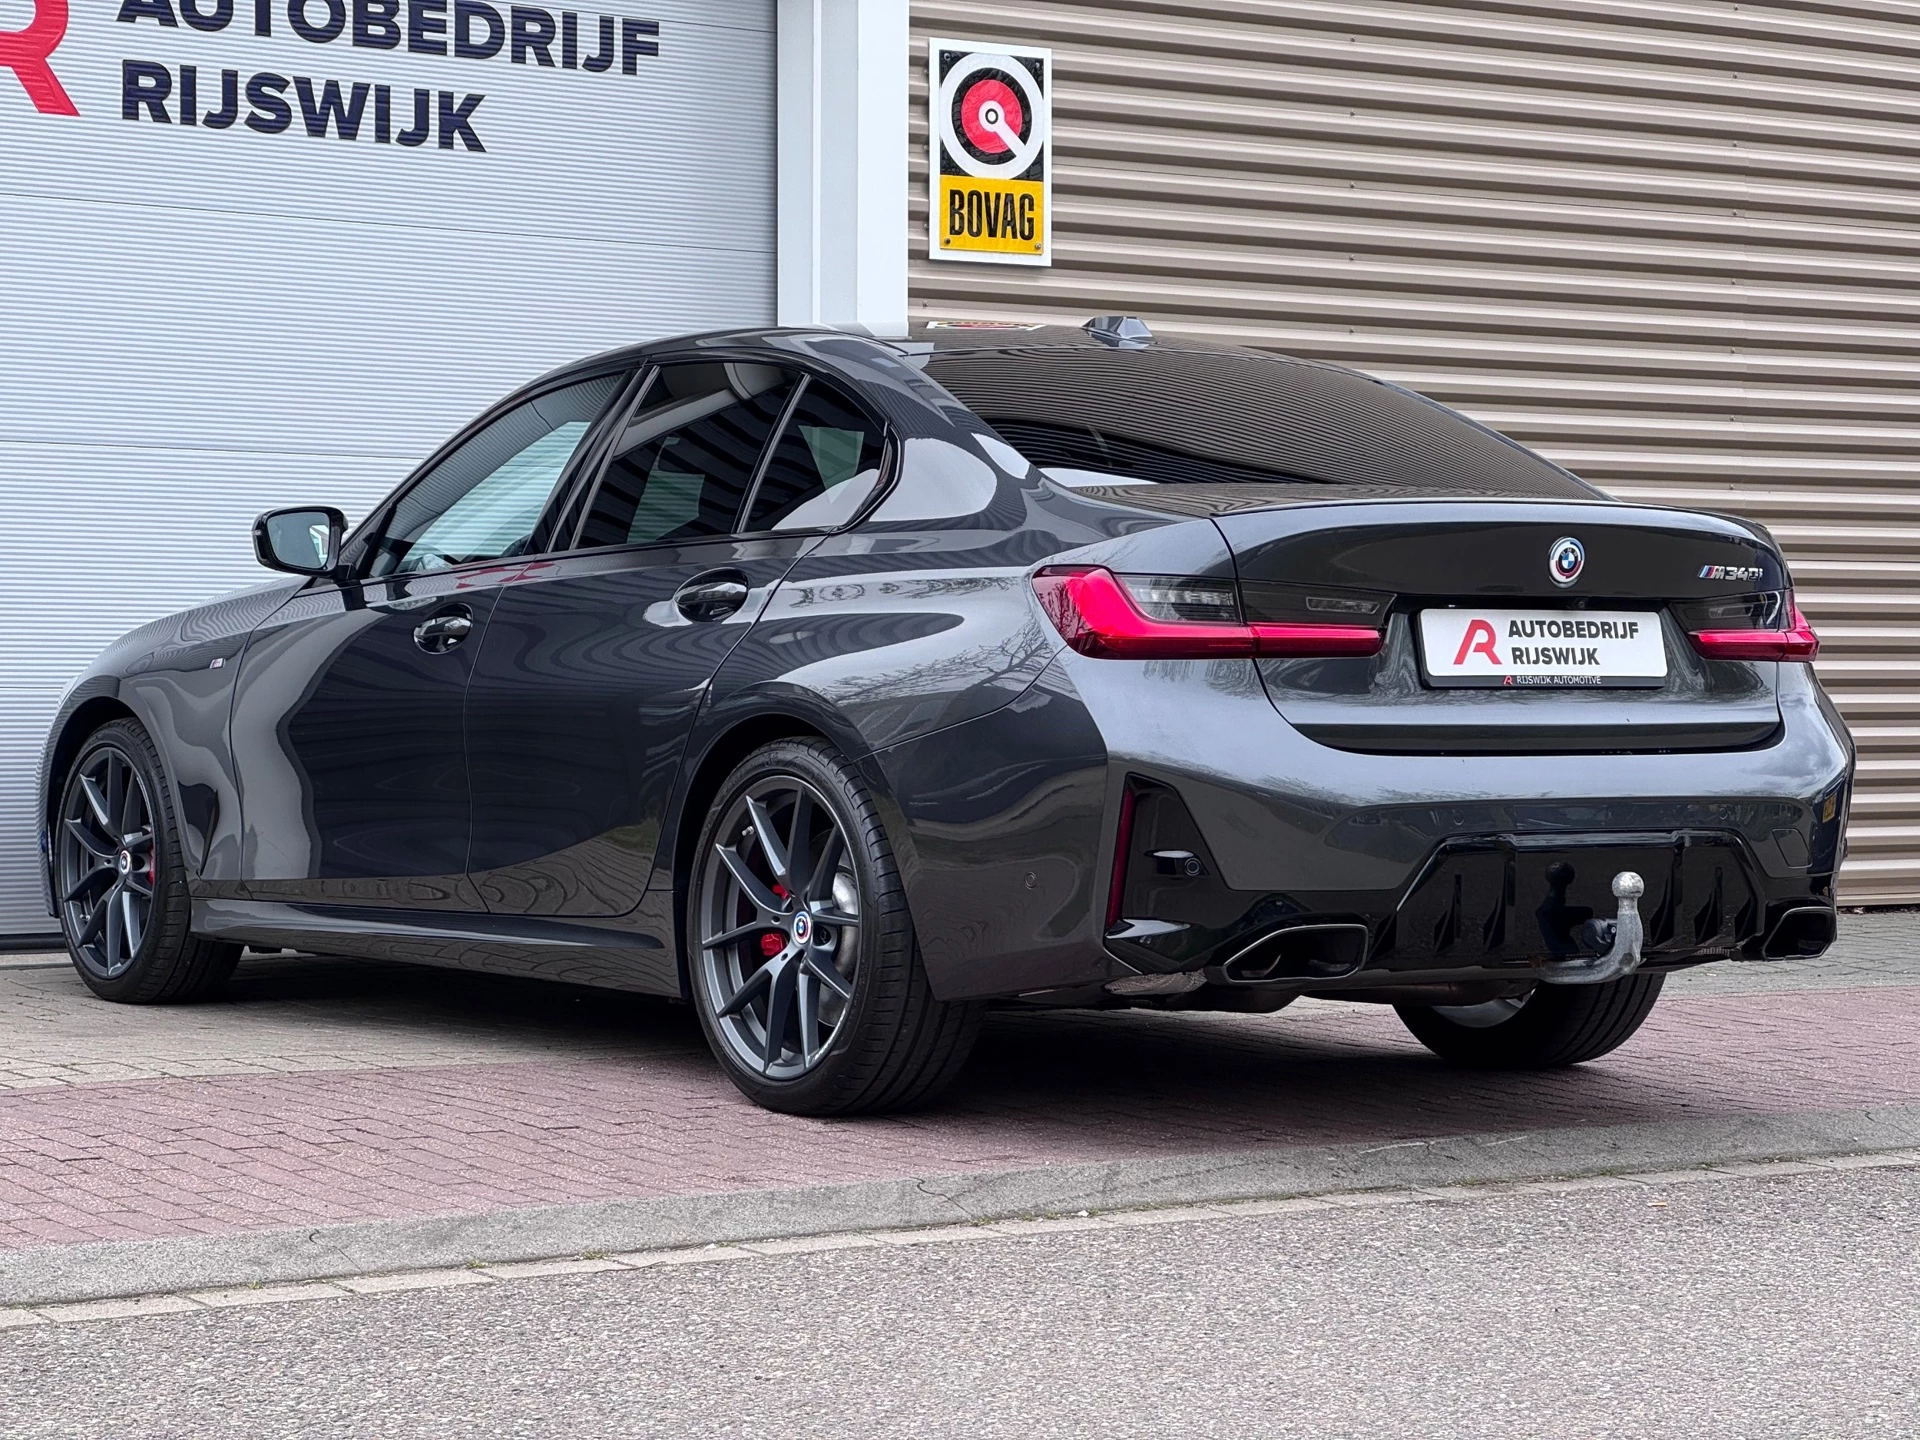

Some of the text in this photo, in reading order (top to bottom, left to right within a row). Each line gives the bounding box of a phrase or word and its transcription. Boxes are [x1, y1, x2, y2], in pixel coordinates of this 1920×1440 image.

[123, 59, 487, 153] RIJSWIJK
[949, 189, 1035, 241] BOVAG
[1711, 565, 1764, 582] M340i
[1508, 619, 1639, 640] AUTOBEDRIJF
[1511, 646, 1600, 666] RIJSWIJK
[1516, 675, 1552, 685] RIJSWIJK
[1553, 675, 1602, 685] AUTOMOTIVE
